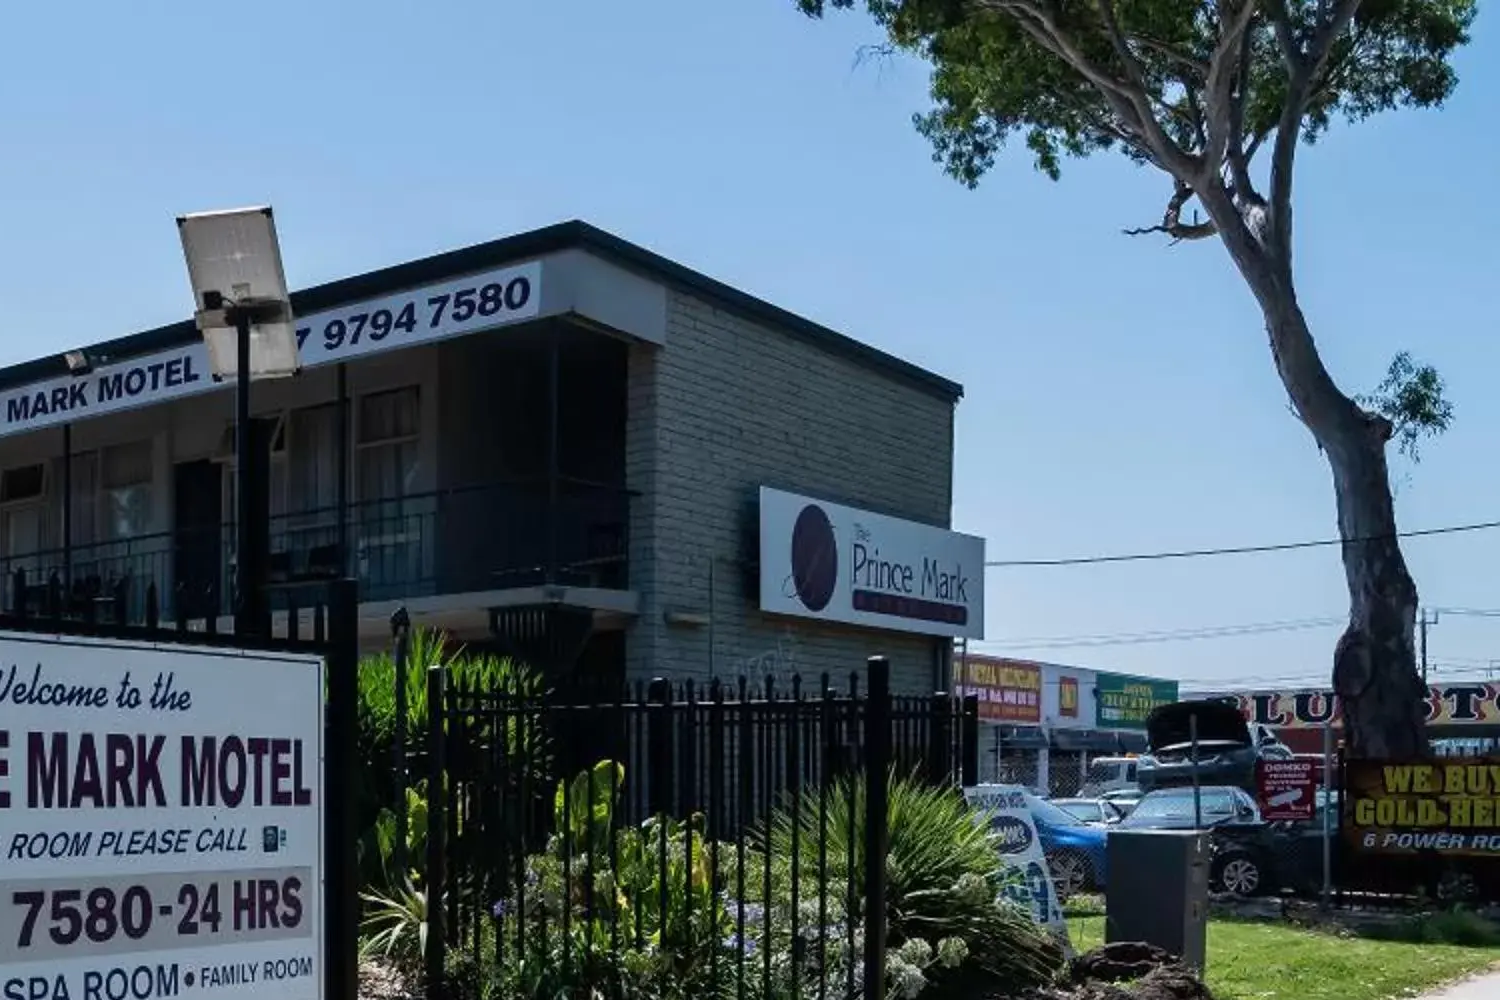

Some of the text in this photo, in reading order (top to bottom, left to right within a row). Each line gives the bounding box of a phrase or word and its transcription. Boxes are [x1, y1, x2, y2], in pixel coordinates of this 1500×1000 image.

[6, 381, 88, 422] MARK
[97, 356, 199, 402] MOTEL
[323, 303, 418, 350] 9794
[428, 276, 532, 326] 7580
[853, 543, 967, 602] Prince Mark
[116, 672, 141, 710] to
[150, 672, 192, 711] the
[27, 731, 167, 809] MARK
[181, 735, 312, 807] MOTEL
[1384, 765, 1432, 793] WE
[1355, 798, 1438, 826] GOLD
[8, 830, 93, 858] ROOM
[97, 828, 191, 856] PLEASE
[195, 826, 248, 852] CALL
[1363, 833, 1376, 847] 6
[1381, 833, 1465, 849] POWER
[233, 876, 303, 930] HRS
[200, 965, 258, 988] FAMILY
[263, 957, 313, 980] ROOM
